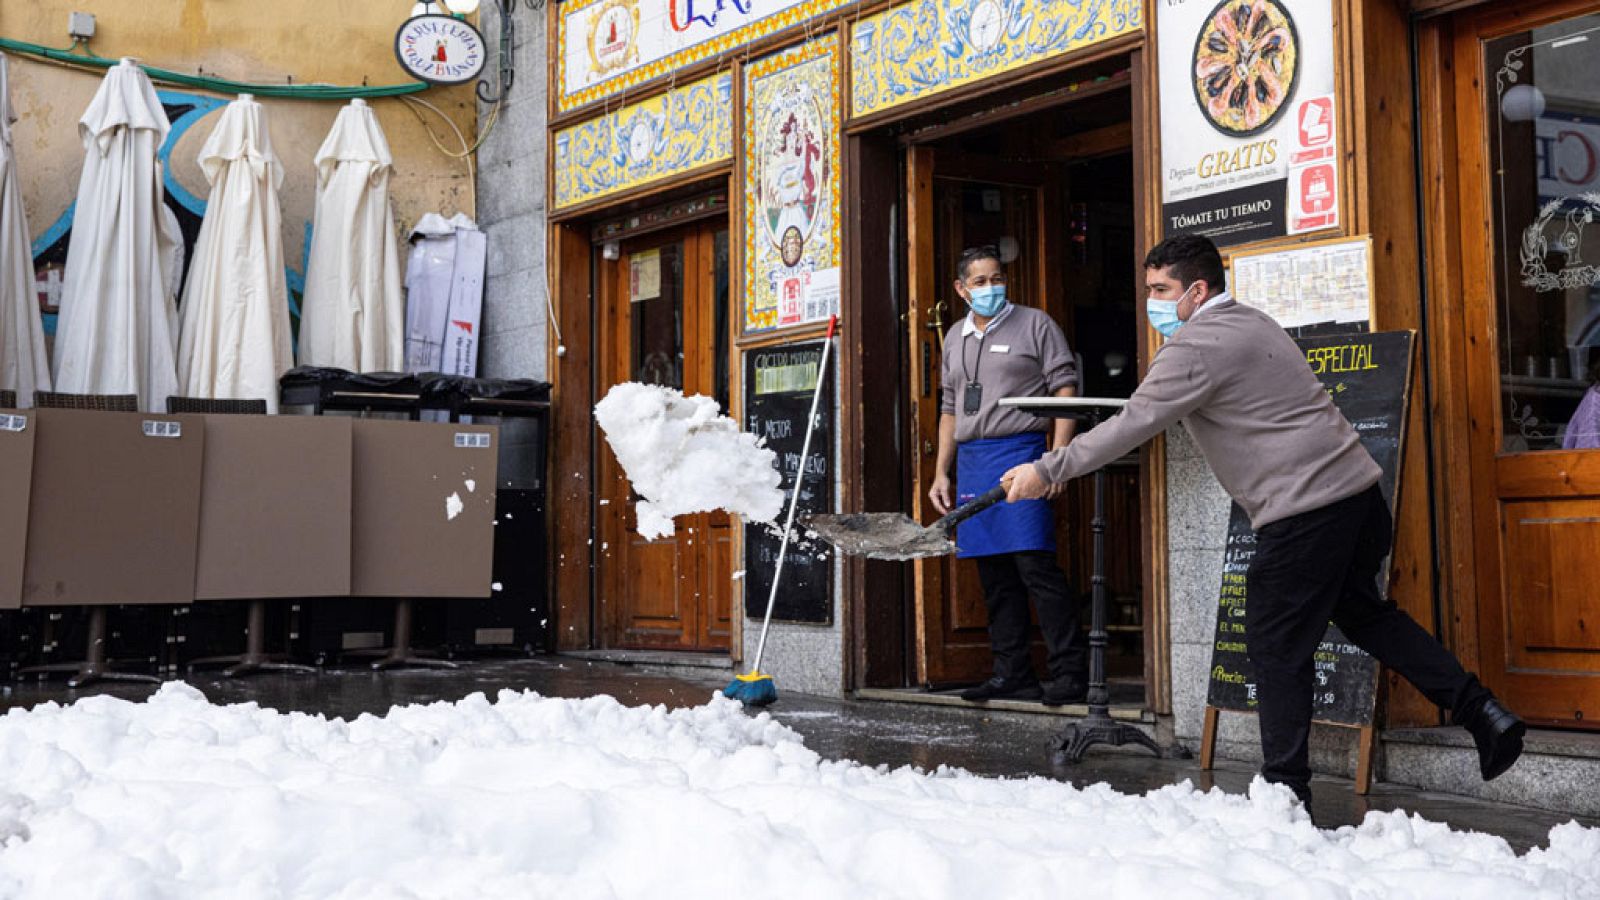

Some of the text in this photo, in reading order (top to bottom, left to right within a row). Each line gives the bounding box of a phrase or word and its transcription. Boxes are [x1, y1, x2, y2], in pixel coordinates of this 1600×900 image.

[1197, 138, 1277, 179] GRATIS
[1171, 211, 1212, 230] TÓMATE
[1214, 207, 1229, 220] TU
[1230, 199, 1272, 218] TIEMPO
[1306, 343, 1379, 374] ESPECIAL
[1245, 683, 1258, 700] TE
